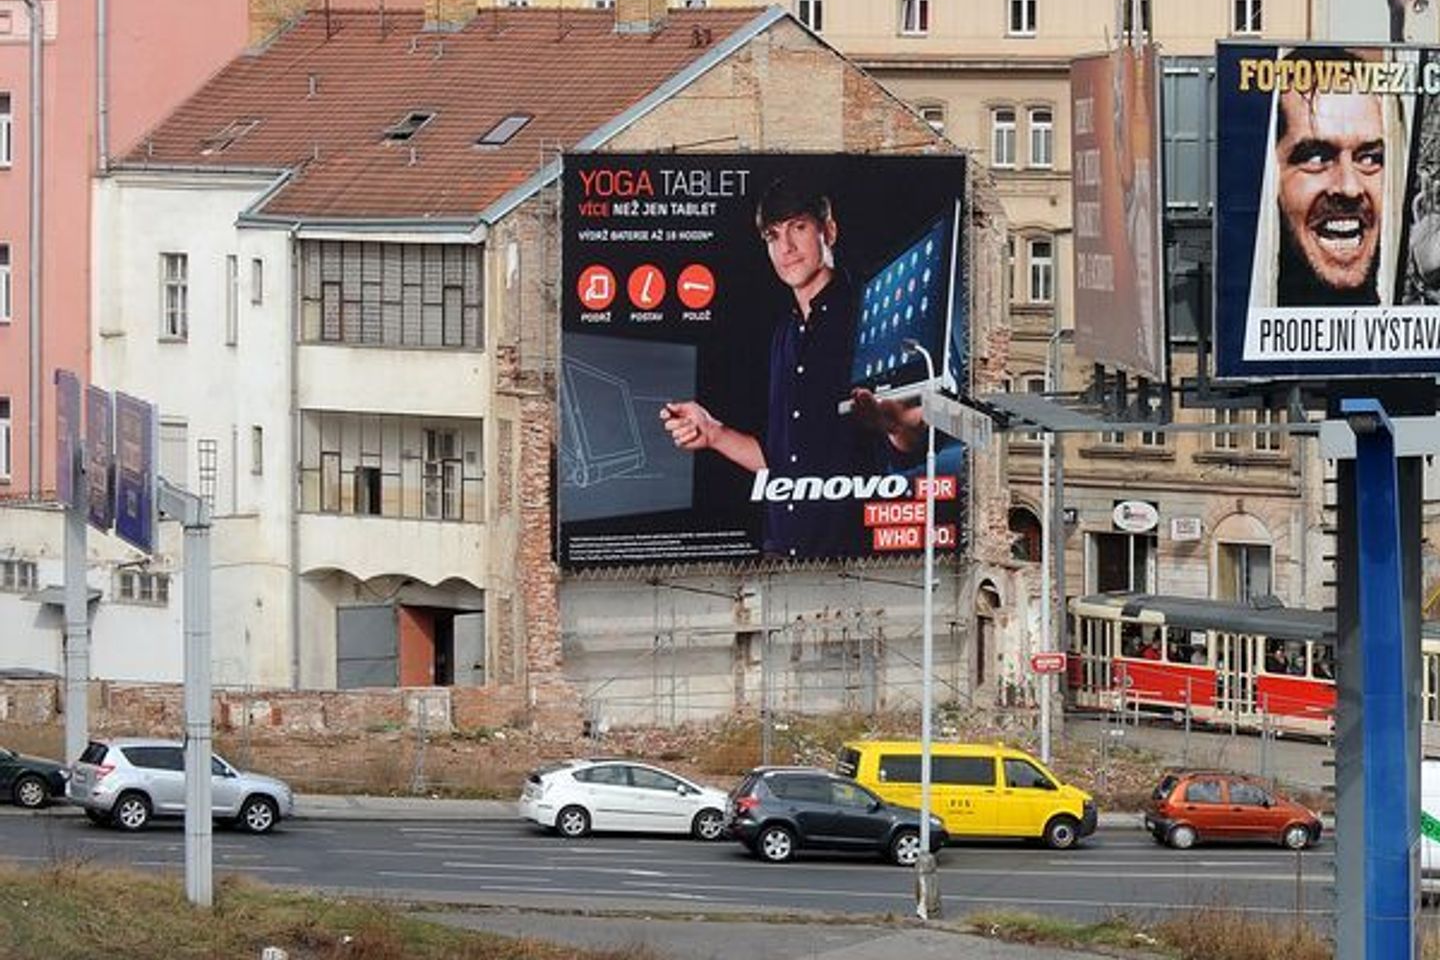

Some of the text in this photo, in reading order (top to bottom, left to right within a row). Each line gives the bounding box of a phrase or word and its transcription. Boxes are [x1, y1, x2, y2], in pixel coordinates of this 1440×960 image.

[578, 170, 750, 196] YOGA TABLET
[612, 199, 639, 216] NEŽ
[642, 202, 668, 216] JEN
[670, 202, 717, 216] TABLET
[1259, 310, 1357, 353] PRODEJNÍ
[867, 505, 925, 522] THOSE
[878, 528, 918, 546] WHO
